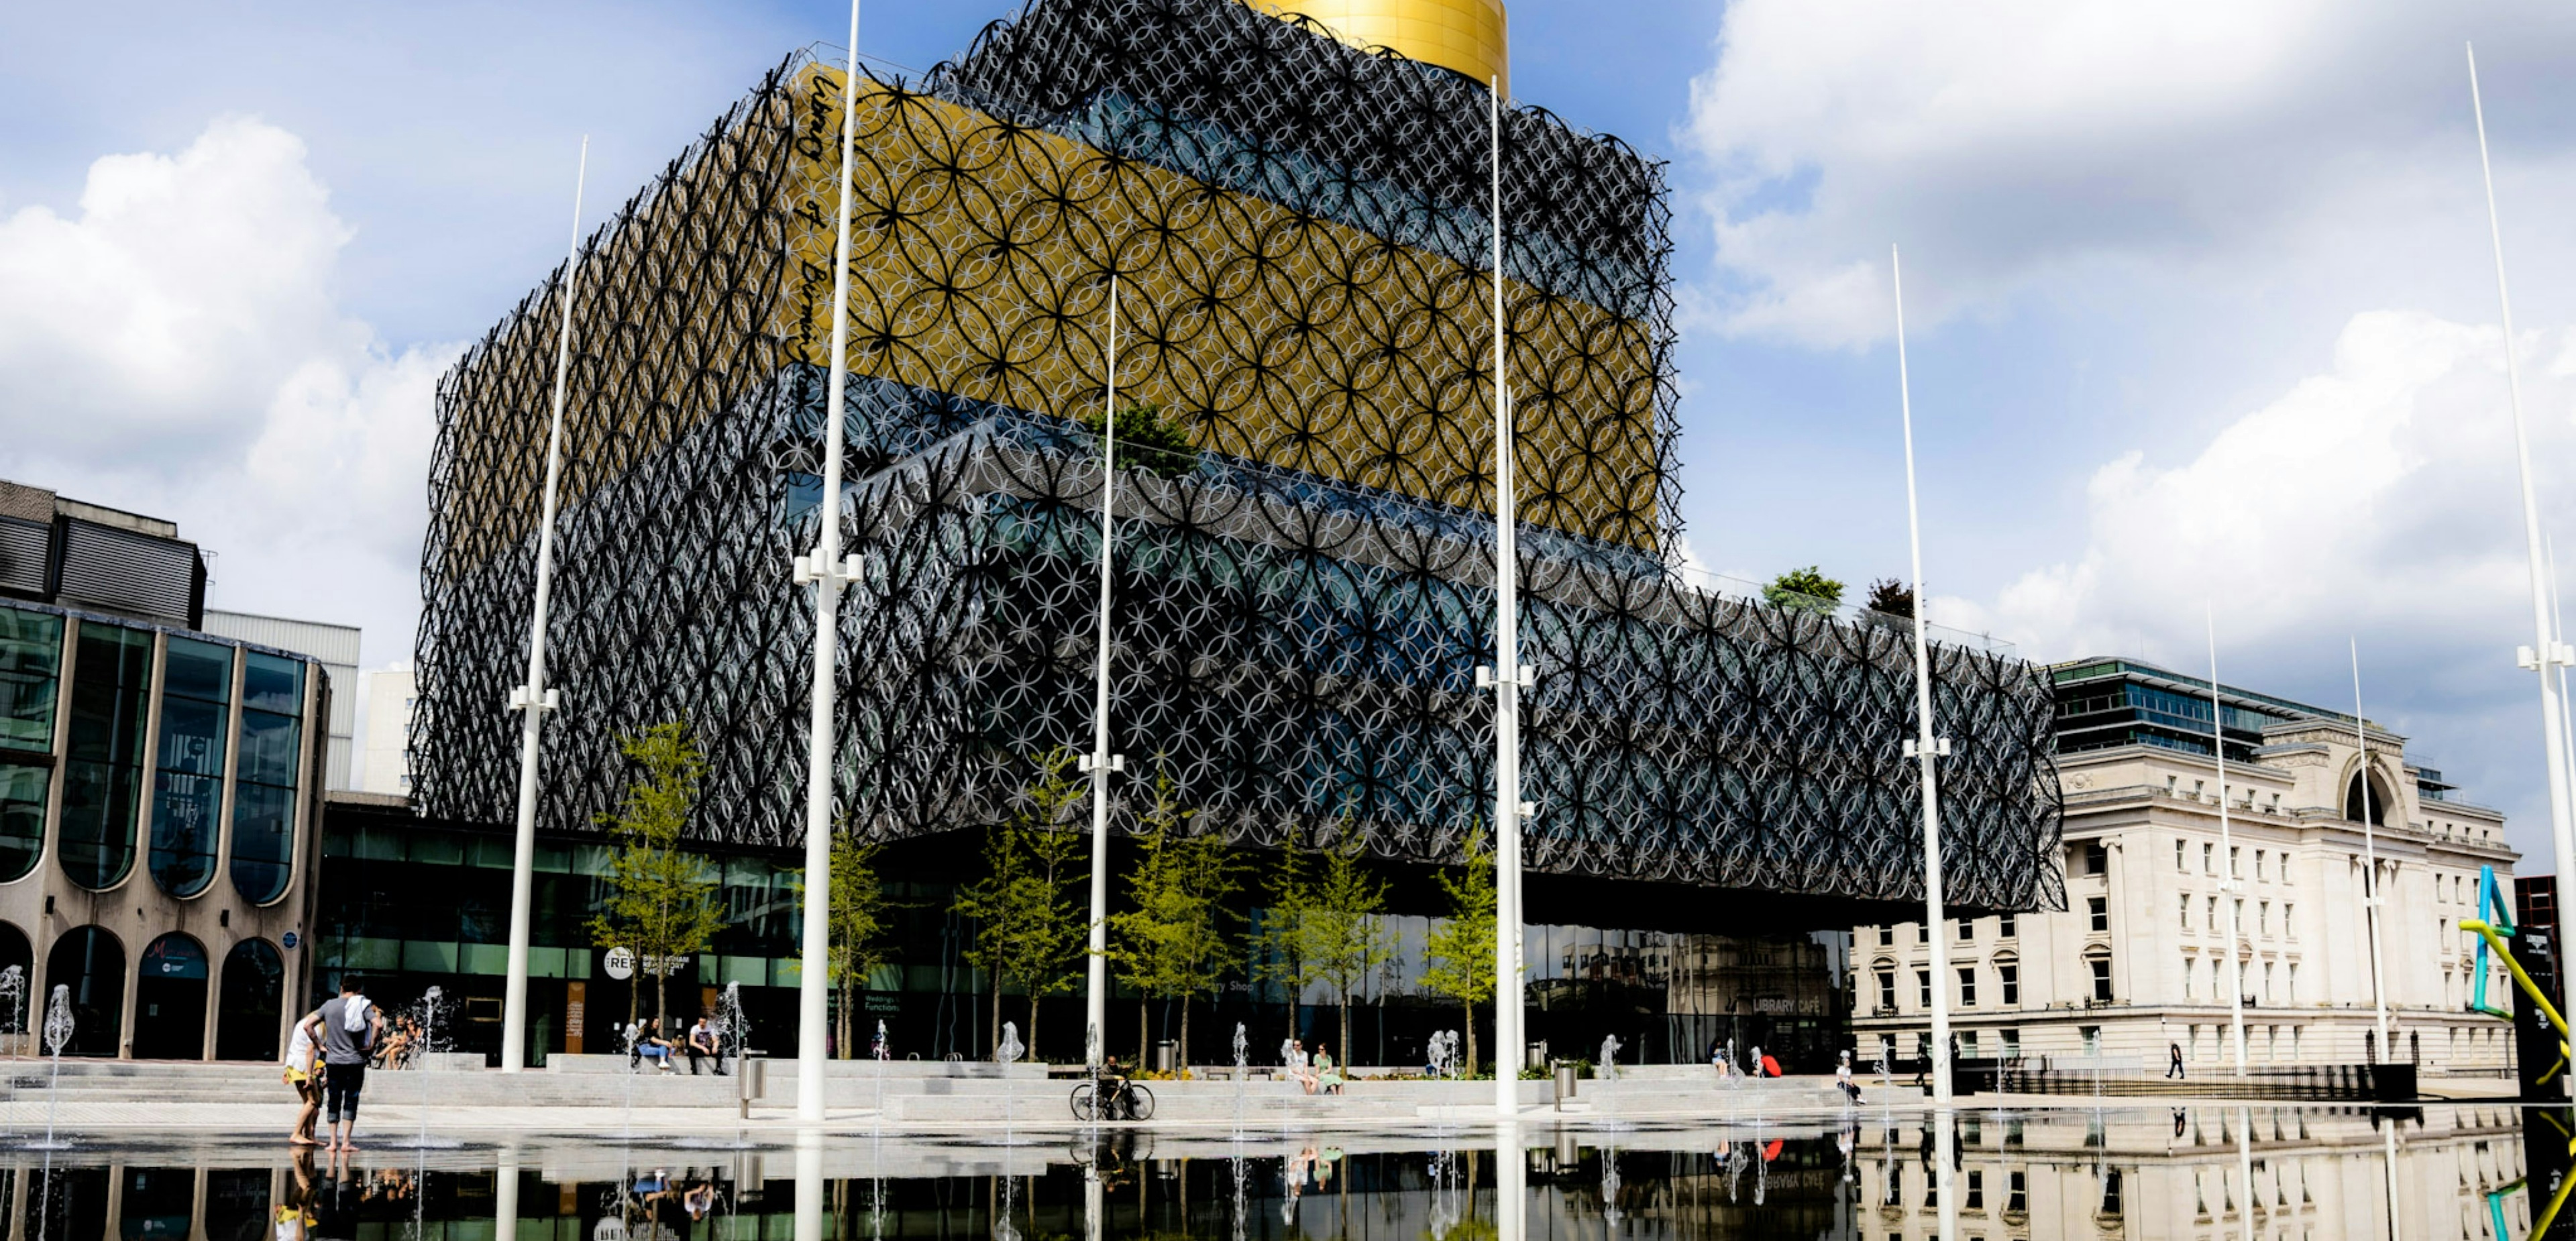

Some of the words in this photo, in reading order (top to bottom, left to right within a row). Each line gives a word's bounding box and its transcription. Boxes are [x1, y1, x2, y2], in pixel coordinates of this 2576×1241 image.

[794, 201, 827, 229] of
[1230, 980, 1254, 993] Shop
[1753, 998, 1794, 1013] LIBRARY
[1799, 995, 1820, 1013] CAFÉ
